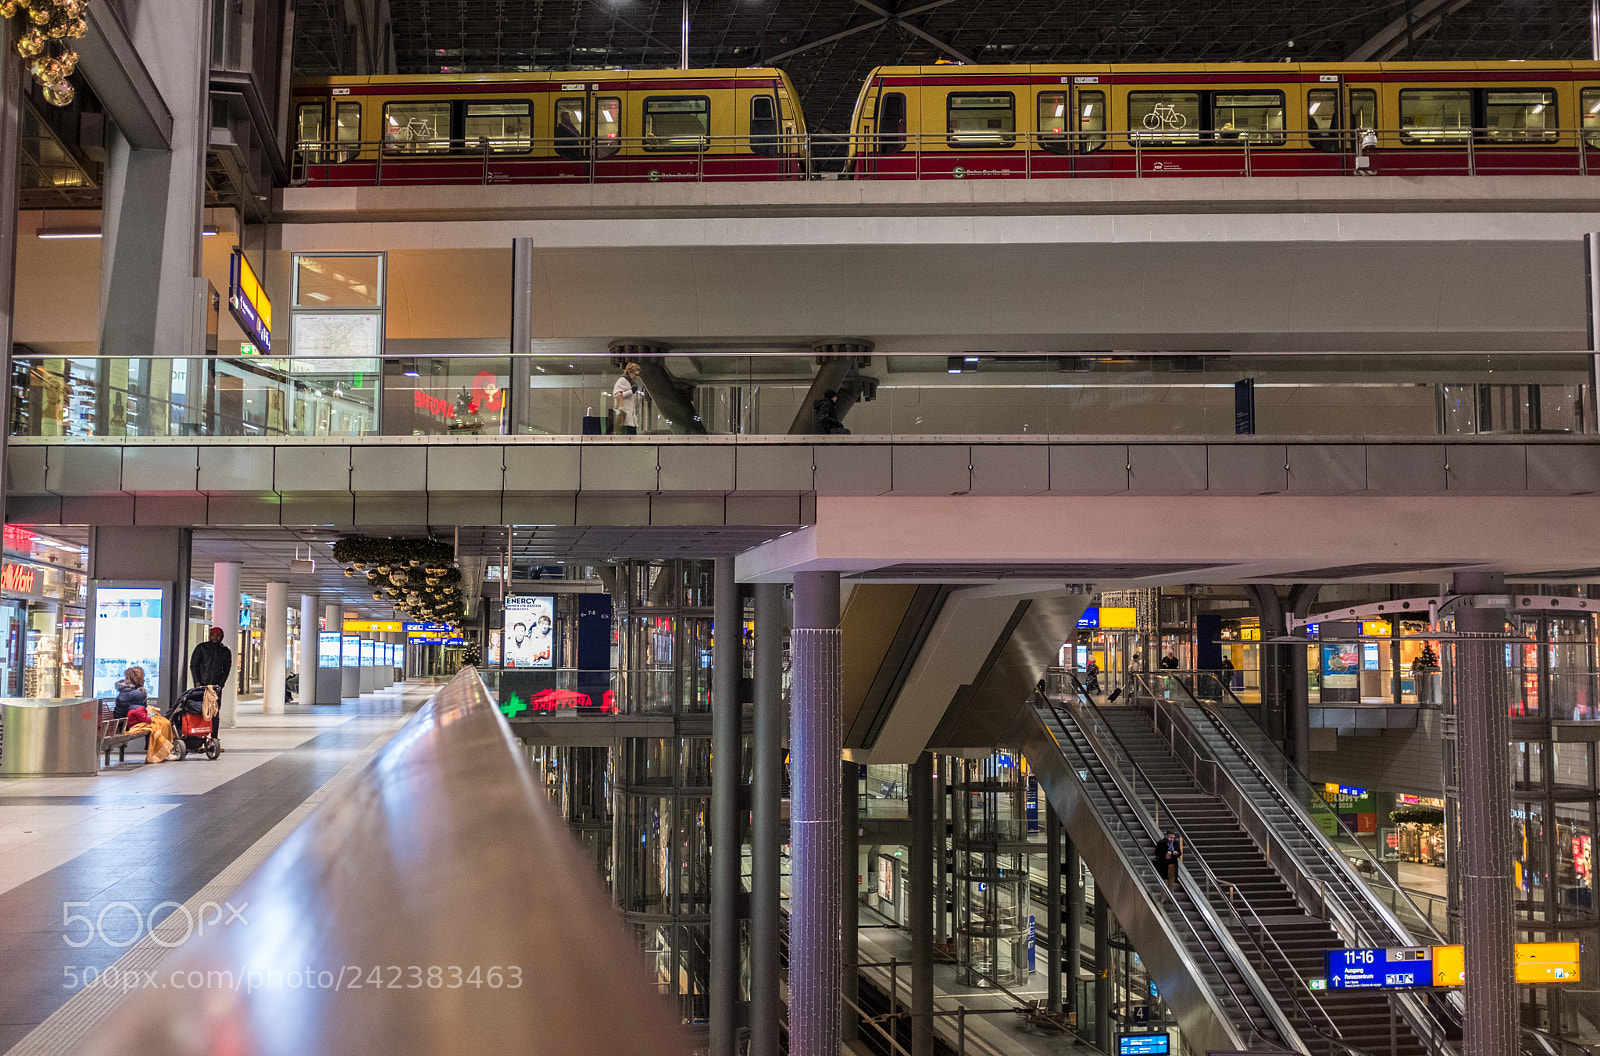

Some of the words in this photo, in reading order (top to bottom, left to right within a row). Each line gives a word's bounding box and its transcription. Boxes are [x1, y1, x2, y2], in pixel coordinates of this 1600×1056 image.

[506, 597, 537, 605] ENERGY
[1344, 950, 1374, 964] 11-16
[1395, 951, 1403, 960] S
[1136, 1007, 1144, 1019] 4
